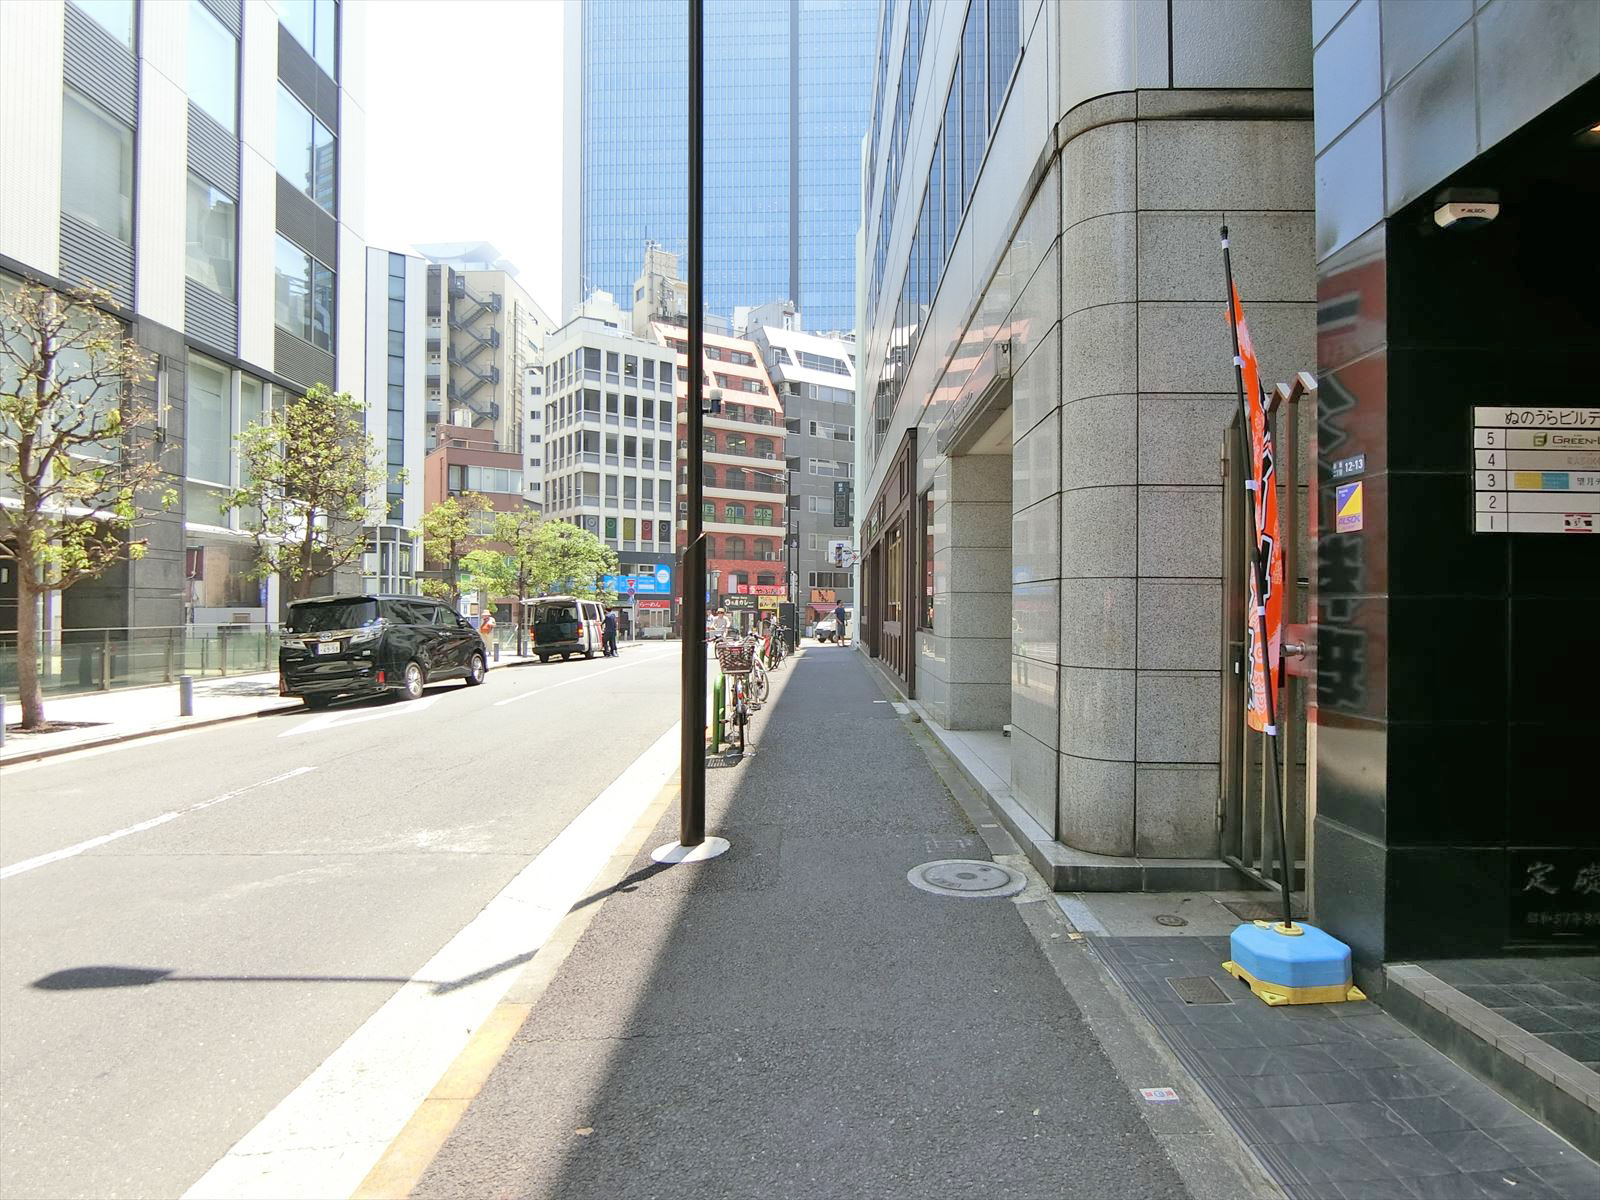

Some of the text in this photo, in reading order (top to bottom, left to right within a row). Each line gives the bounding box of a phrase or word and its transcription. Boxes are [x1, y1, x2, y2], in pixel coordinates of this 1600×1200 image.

[1487, 432, 1495, 445] 5
[1552, 435, 1600, 445] GREEN-
[1345, 459, 1363, 472] 12-13
[1488, 453, 1496, 466] 4
[1488, 474, 1496, 487] 3
[1489, 496, 1497, 508] 2
